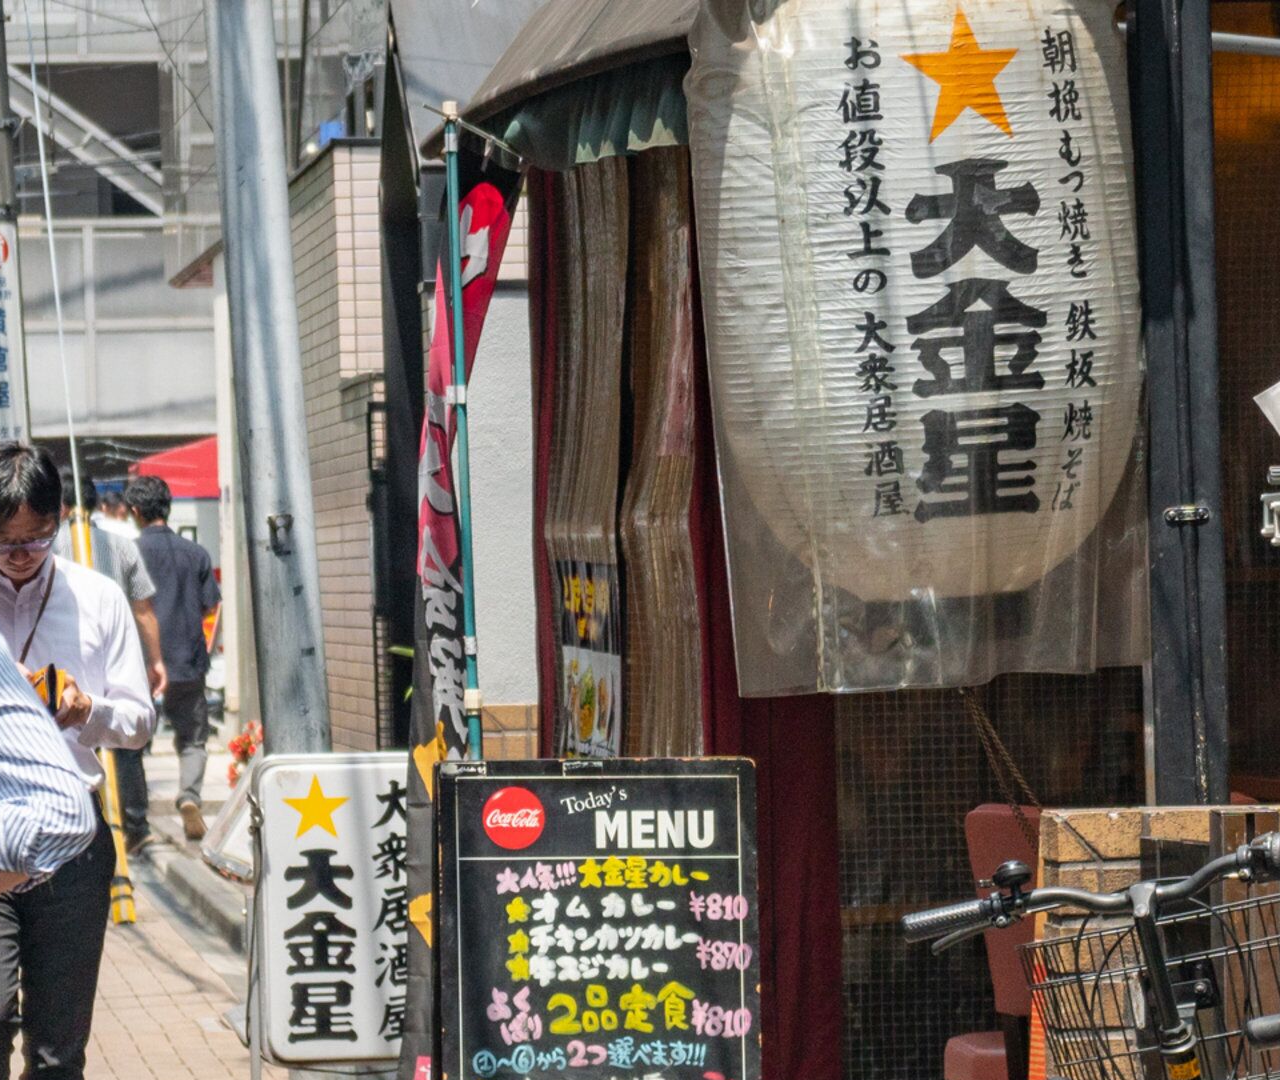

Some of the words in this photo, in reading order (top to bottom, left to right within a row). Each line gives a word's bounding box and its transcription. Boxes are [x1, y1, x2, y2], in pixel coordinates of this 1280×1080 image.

[904, 158, 1048, 523] 大金星
[561, 786, 628, 815] Today's
[594, 810, 715, 849] MENU
[531, 892, 676, 923] オムカレー
[284, 848, 358, 1043] 大金星
[530, 923, 700, 953] チキンカツカレー
[546, 980, 696, 1035] 2品定食
